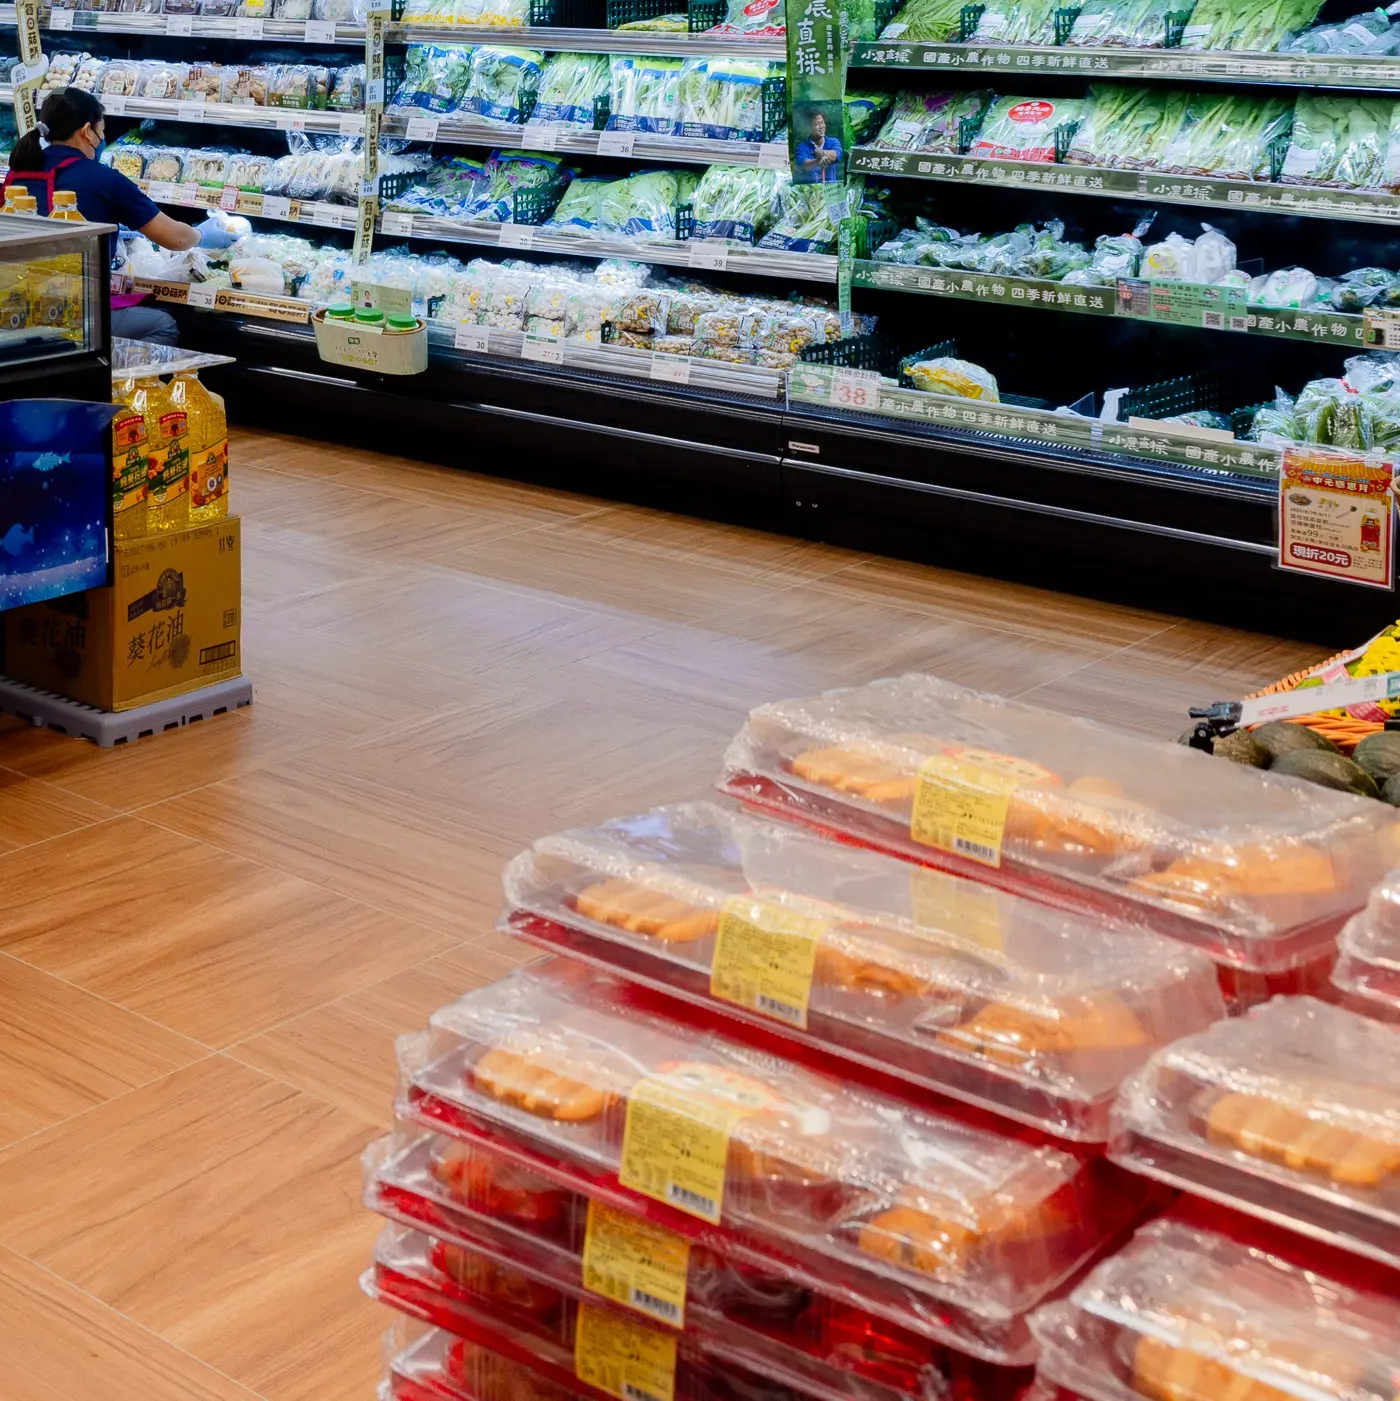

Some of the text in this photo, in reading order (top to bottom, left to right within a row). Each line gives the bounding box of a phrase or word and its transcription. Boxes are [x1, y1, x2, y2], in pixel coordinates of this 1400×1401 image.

[861, 48, 1109, 70] 小農直採 國產小農作物 四季新鮮直送
[856, 155, 1104, 189] 小農直採 國產小農作物 四季新鮮直送
[918, 276, 1005, 296] 國產小農作物
[1011, 286, 1104, 309] 四季新鮮直送
[838, 384, 867, 406] 38
[882, 397, 1057, 436] 產小農作物 四季新鮮直送
[1312, 476, 1369, 493] 中元感恩月
[1292, 545, 1349, 566] 現折20元
[127, 609, 184, 668] 葵花油
